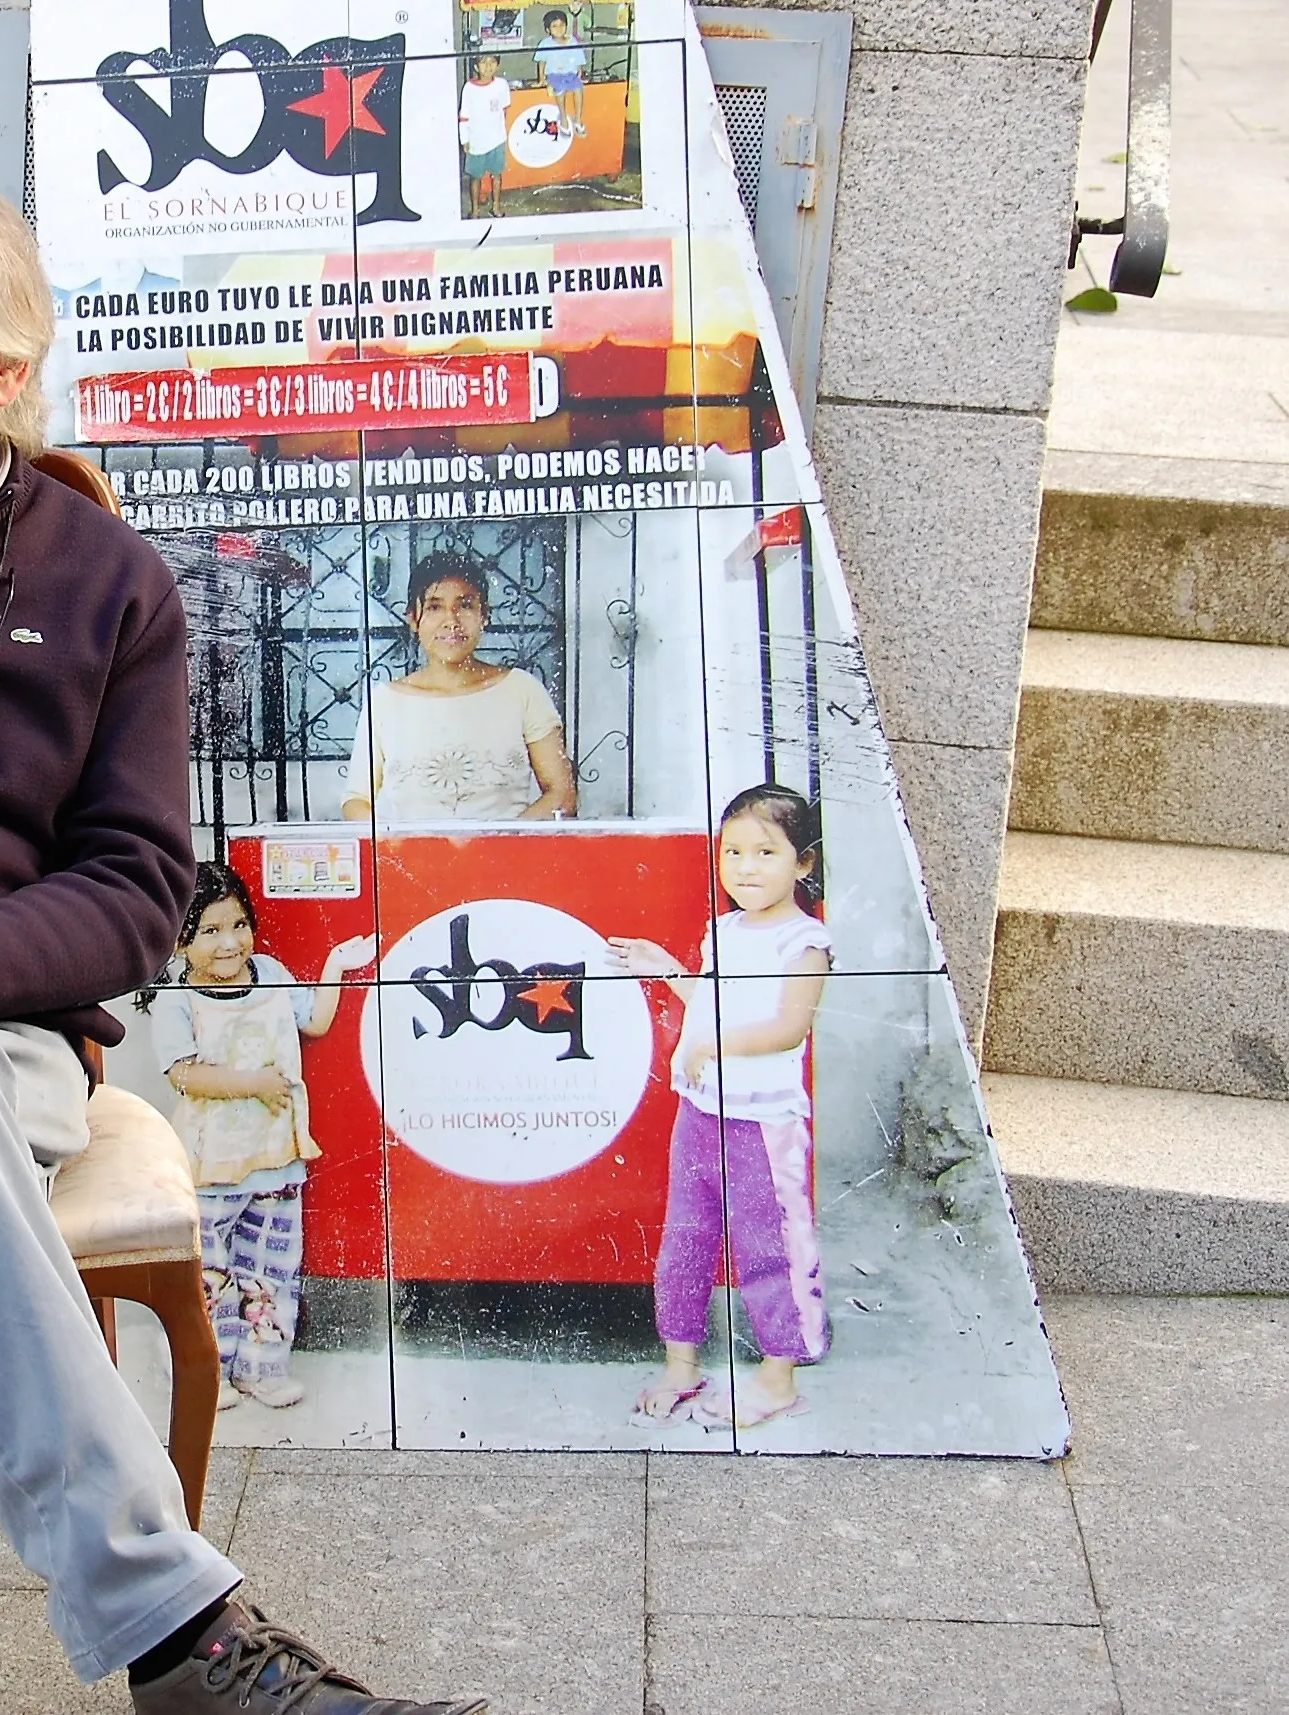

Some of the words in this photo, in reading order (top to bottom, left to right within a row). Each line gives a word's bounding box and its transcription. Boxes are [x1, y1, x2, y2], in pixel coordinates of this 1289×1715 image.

[104, 202, 131, 221] EL
[148, 190, 348, 220] SORNABIQUE
[105, 221, 204, 238] ORGANIZACIÓN
[208, 222, 227, 233] NO
[230, 216, 348, 232] GUBERNAMENTAL
[75, 293, 139, 319] CADA
[148, 289, 209, 315] EURO
[218, 286, 279, 312] TUYO
[289, 284, 312, 308] LE
[322, 283, 352, 306] DA
[360, 281, 373, 304] A
[382, 278, 431, 303] UNA
[440, 271, 540, 299] FAMILIA
[548, 264, 663, 293] PERUANA
[77, 329, 103, 353] LA
[112, 323, 266, 351] POSIBILIDAD
[275, 320, 303, 344] DE
[318, 315, 384, 341] VIVIR
[394, 305, 553, 338] DIGNAMENTE
[133, 468, 199, 495] CADA
[206, 465, 254, 493] 200
[262, 462, 351, 491] LIBROS
[498, 446, 621, 481] PODEMOS
[345, 494, 410, 522] PARA
[417, 491, 466, 519] UNA
[475, 485, 579, 517] FAMILIA
[442, 1111, 527, 1129] HICIMOS
[532, 1110, 617, 1131] JUNTOS!
